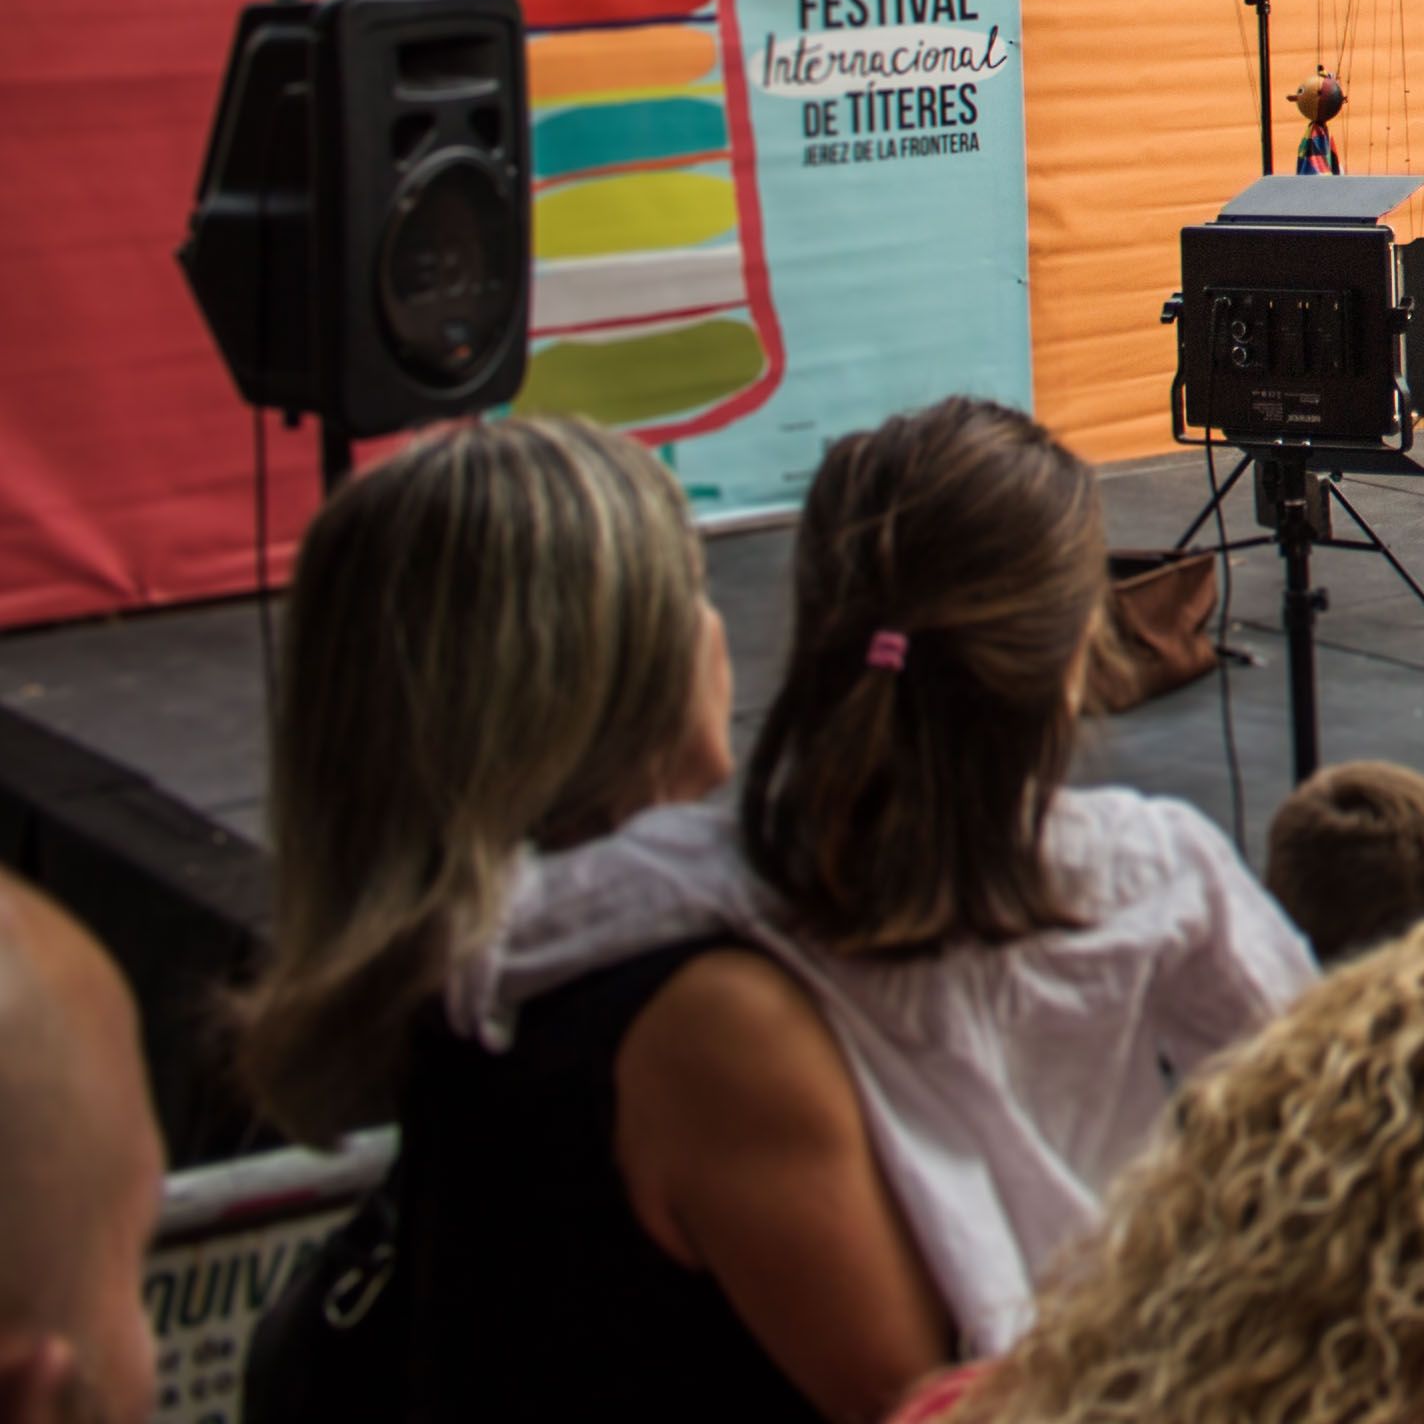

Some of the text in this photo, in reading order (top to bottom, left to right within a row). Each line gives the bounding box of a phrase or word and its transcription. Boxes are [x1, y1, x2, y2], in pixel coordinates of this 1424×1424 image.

[763, 25, 1008, 88] Internacional
[803, 81, 978, 139] DE TÍTERES
[803, 131, 981, 168] JEREZ DE LA FRONTERA
